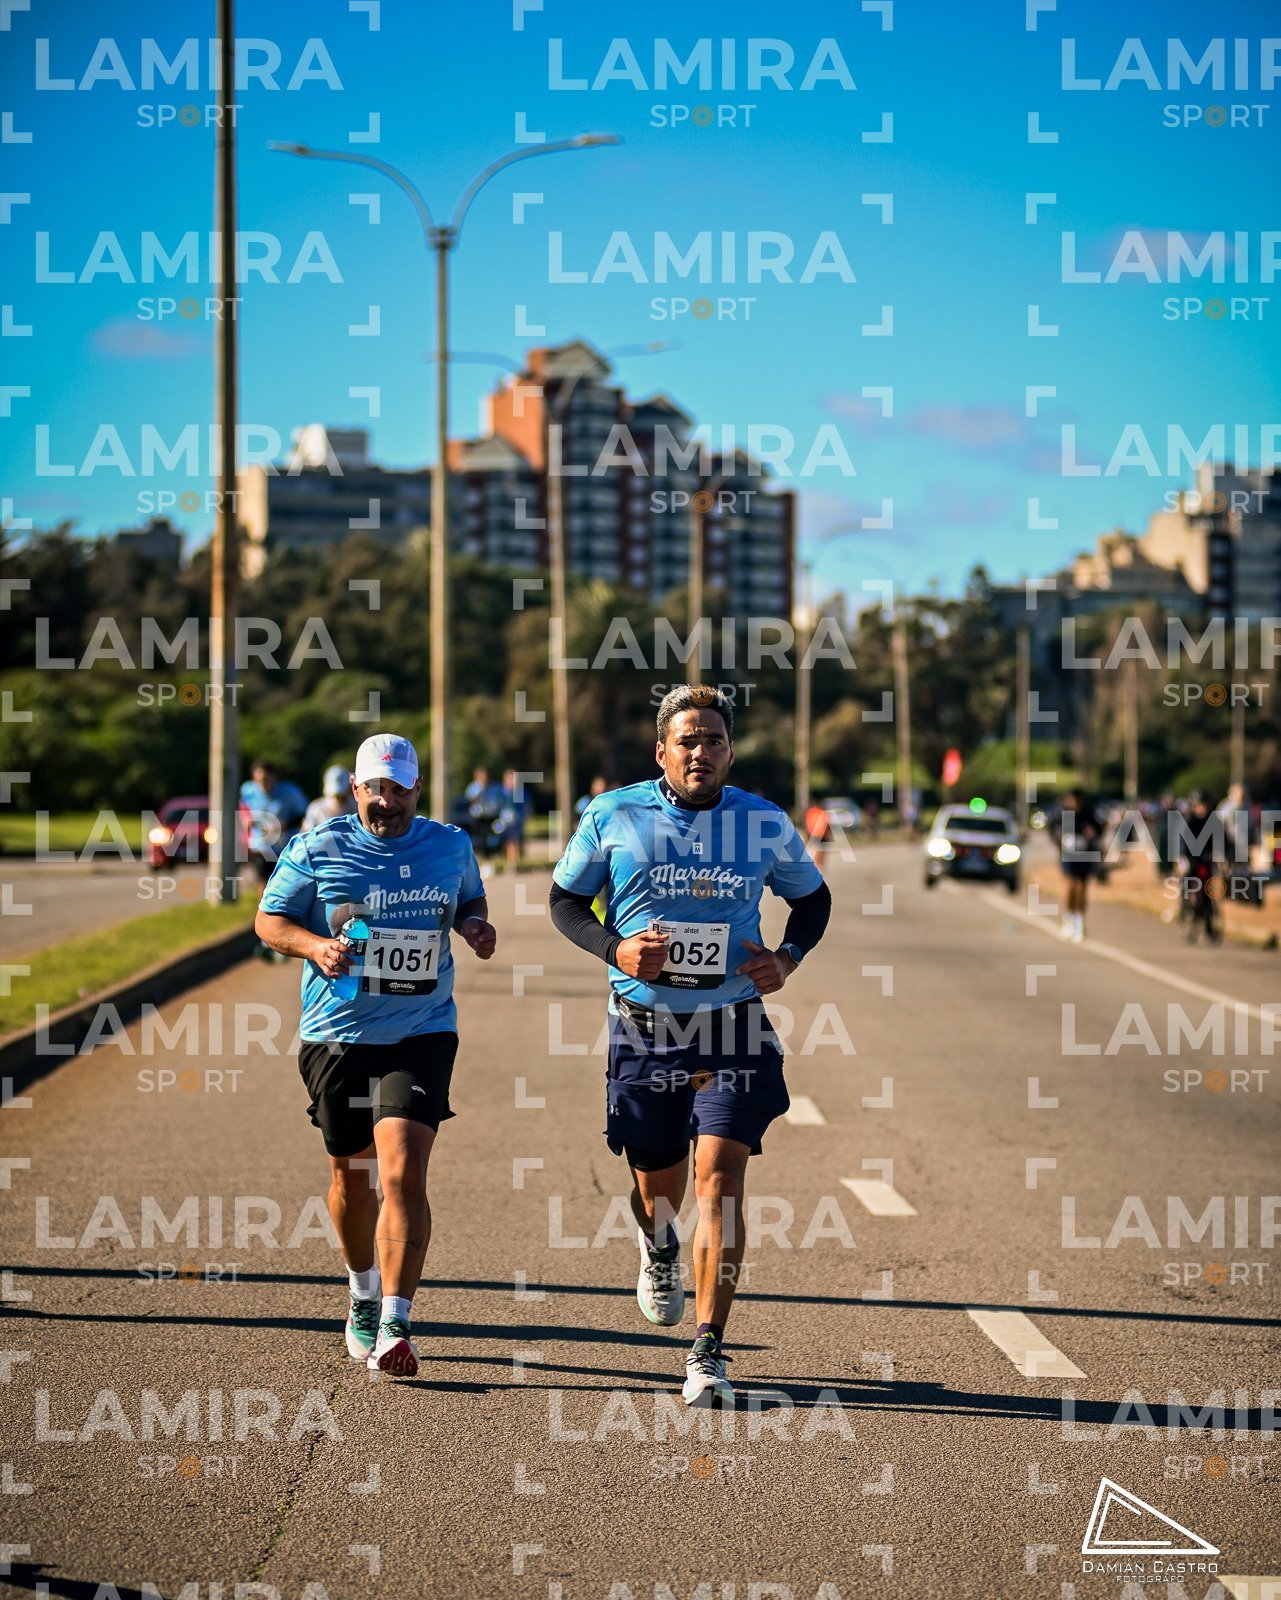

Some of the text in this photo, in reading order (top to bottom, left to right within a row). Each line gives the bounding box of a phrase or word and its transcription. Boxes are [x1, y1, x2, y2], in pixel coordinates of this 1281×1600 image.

[649, 863, 744, 888] Maratón
[363, 885, 450, 910] Maratón
[658, 888, 734, 898] MONTEVIDEO
[372, 907, 445, 920] MONTEVIDEO
[372, 946, 433, 973] 1051
[669, 940, 721, 967] 052
